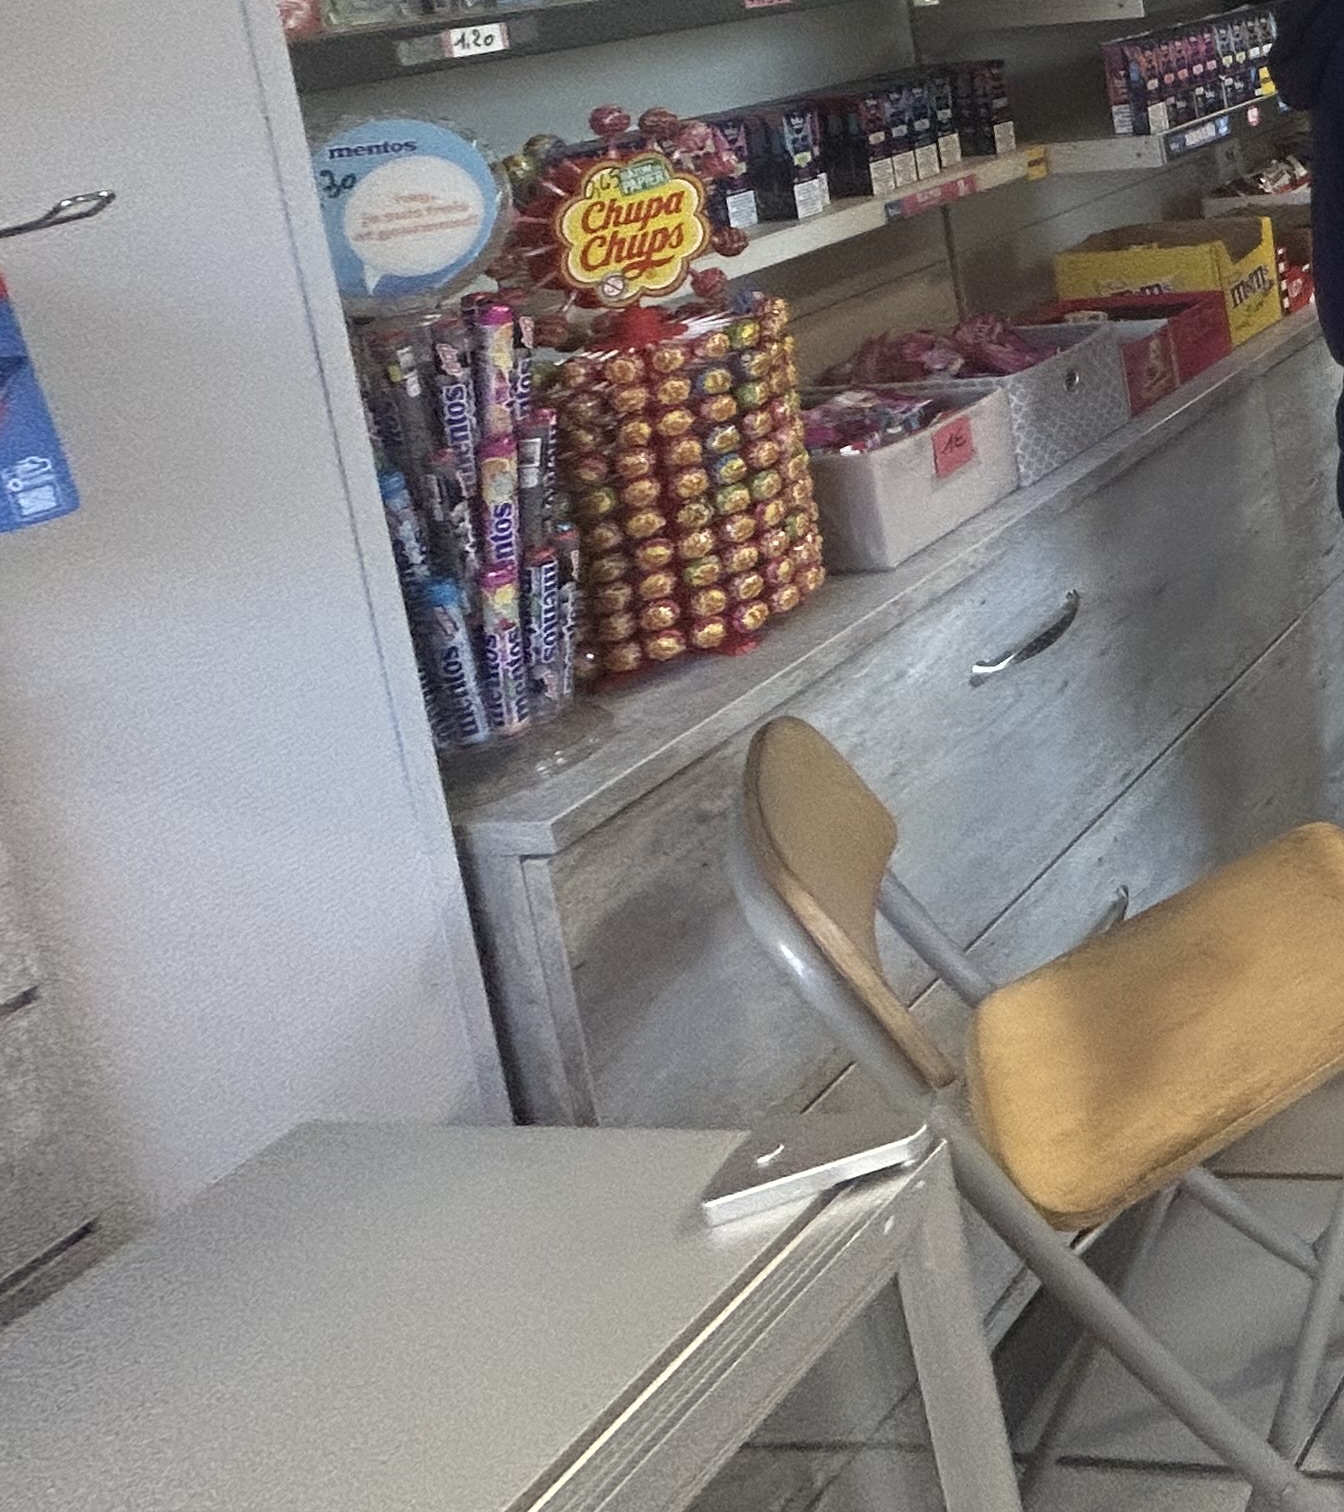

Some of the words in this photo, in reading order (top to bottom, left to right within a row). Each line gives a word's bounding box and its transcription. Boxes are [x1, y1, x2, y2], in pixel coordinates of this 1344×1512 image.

[329, 140, 417, 160] mentos
[622, 172, 666, 196] PAPIER
[581, 190, 685, 234] Chupa
[580, 222, 684, 279] Chups
[541, 561, 560, 664] mentos
